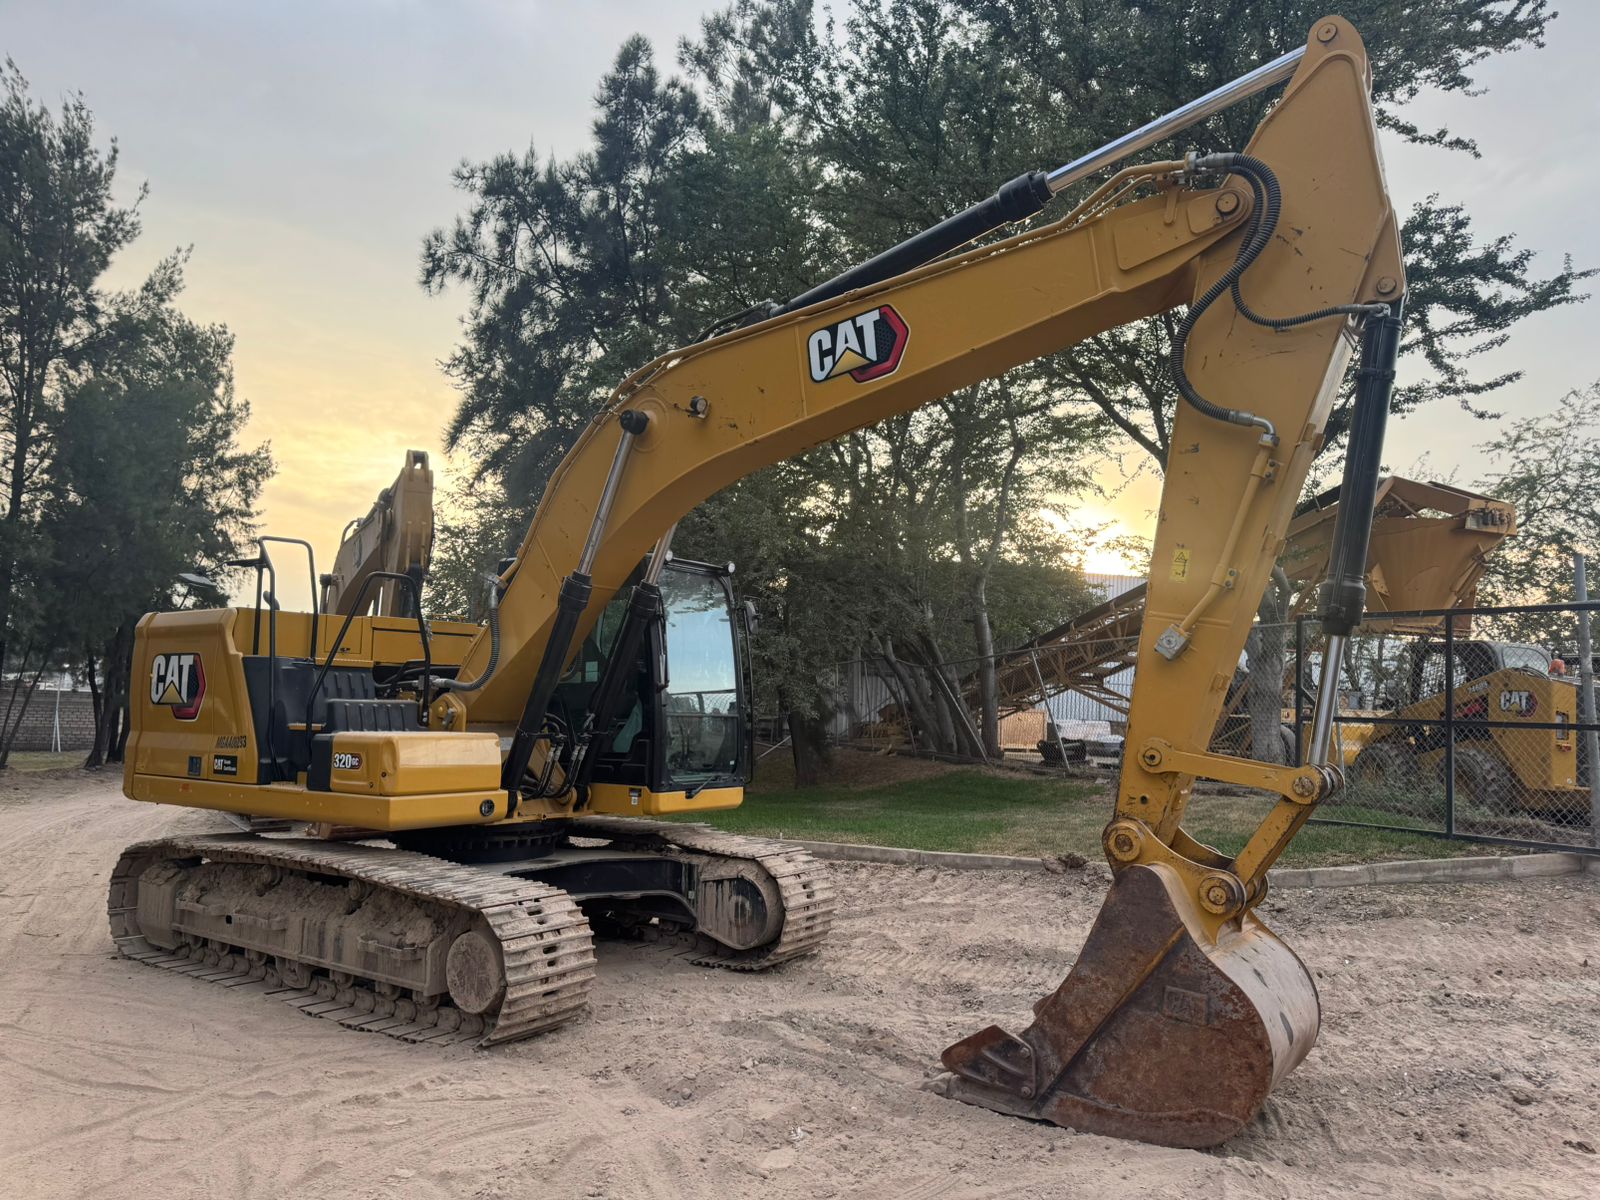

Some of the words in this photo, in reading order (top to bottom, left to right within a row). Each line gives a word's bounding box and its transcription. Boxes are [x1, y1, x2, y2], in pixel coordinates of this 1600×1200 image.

[808, 309, 881, 381] CAT
[151, 654, 194, 703] CAT
[1500, 690, 1529, 711] CAT
[333, 753, 351, 768] 320
